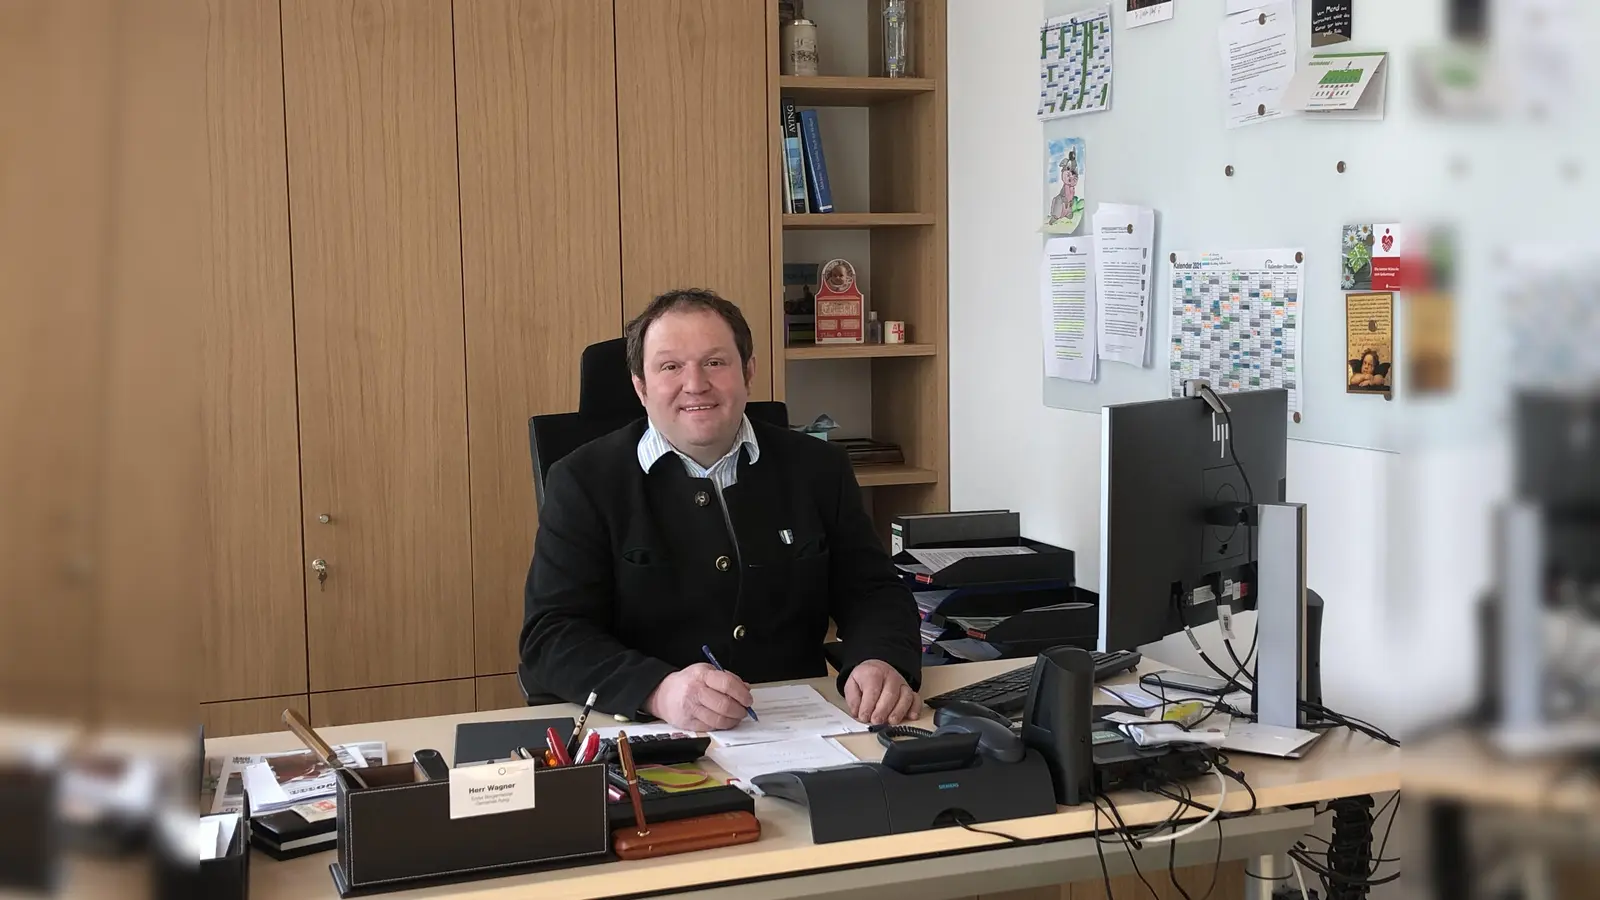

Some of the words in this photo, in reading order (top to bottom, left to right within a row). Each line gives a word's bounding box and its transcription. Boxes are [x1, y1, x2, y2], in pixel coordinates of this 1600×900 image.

[1325, 4, 1340, 14] Mond
[786, 104, 797, 133] AYING
[487, 783, 516, 791] Wagner
